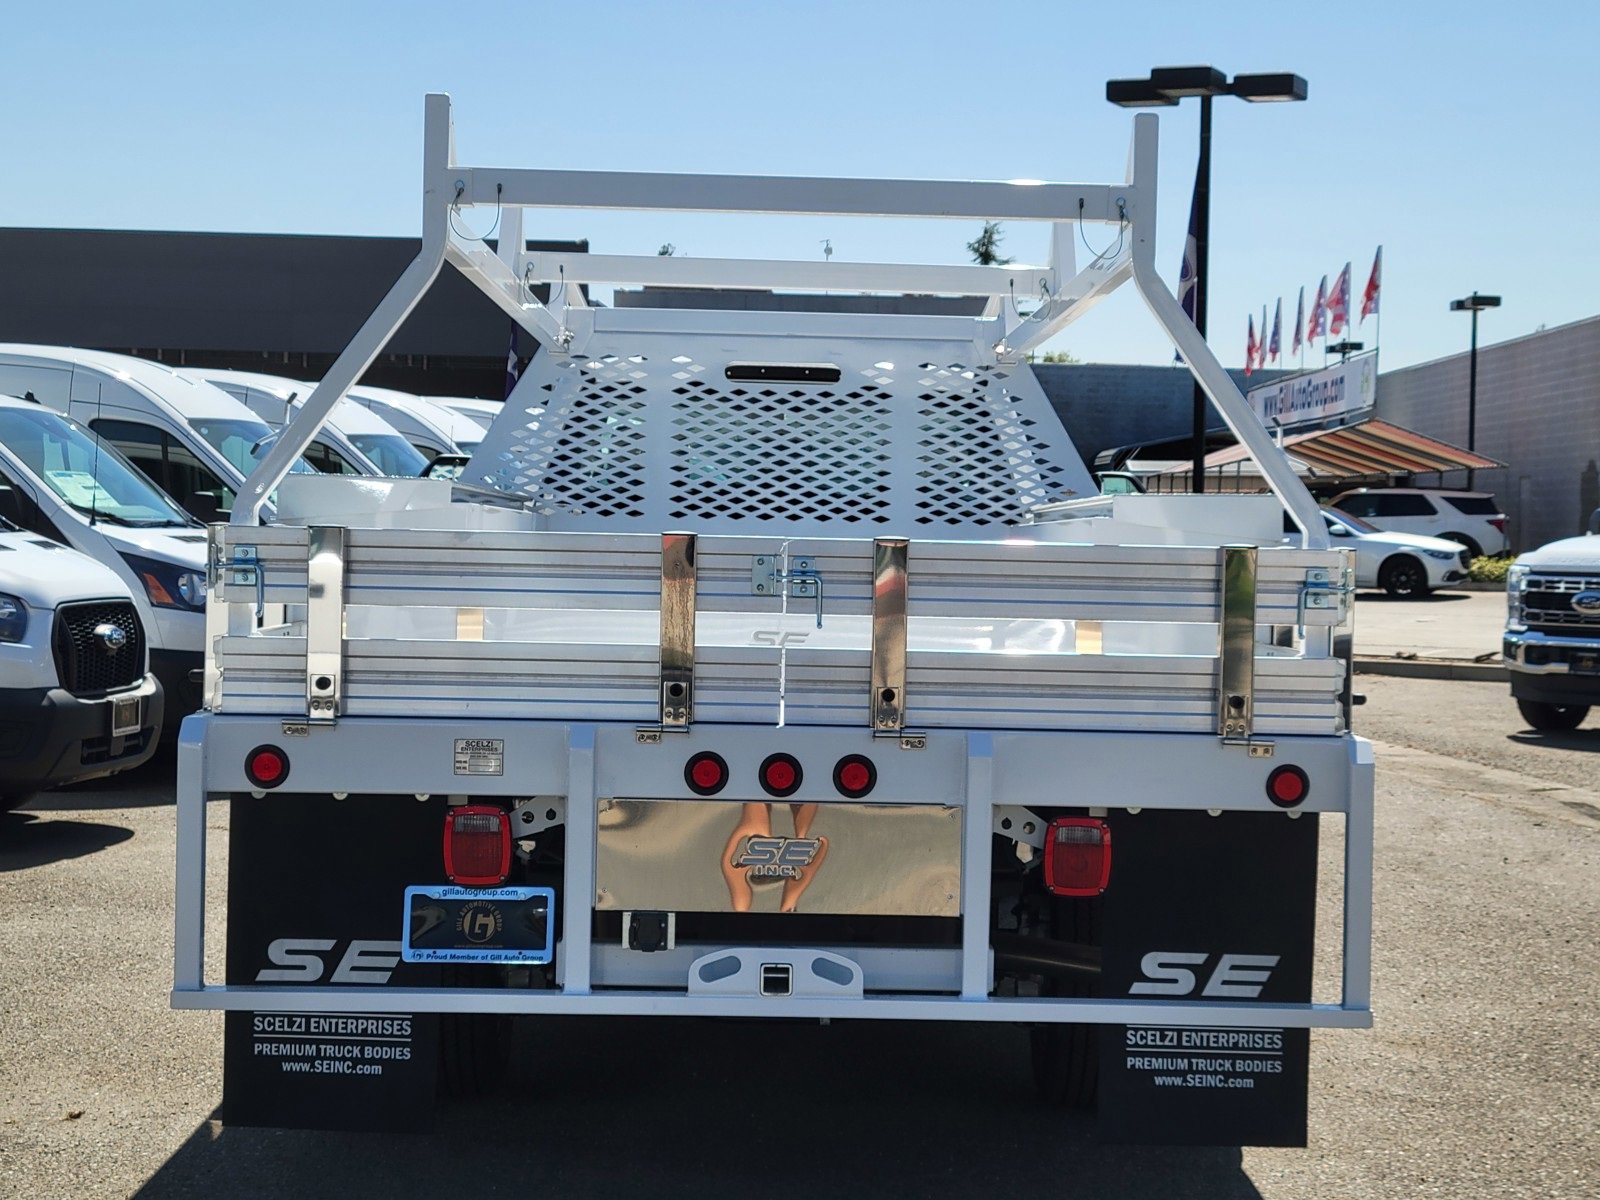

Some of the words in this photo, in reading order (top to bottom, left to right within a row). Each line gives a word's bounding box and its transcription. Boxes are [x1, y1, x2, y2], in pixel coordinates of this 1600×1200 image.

[442, 887, 518, 898] gillautogroup.com
[255, 938, 404, 984] SE
[426, 953, 448, 961] Proud
[1128, 951, 1281, 998] SE
[253, 1017, 305, 1032] SCELZI
[310, 1018, 412, 1035] ENTERPRISES
[1126, 1030, 1177, 1046] SCELZI
[1182, 1031, 1282, 1048] ENTERPRISES
[254, 1043, 316, 1056] PREMIUM
[319, 1045, 361, 1058] TRUCK
[364, 1046, 411, 1060] BODIES
[282, 1060, 382, 1075] www.SEINC.com
[1127, 1057, 1188, 1070] PREMIUM
[1191, 1058, 1233, 1072] TRUCK
[1236, 1059, 1282, 1073] BODIES
[1154, 1074, 1254, 1088] www.SEINC.com
